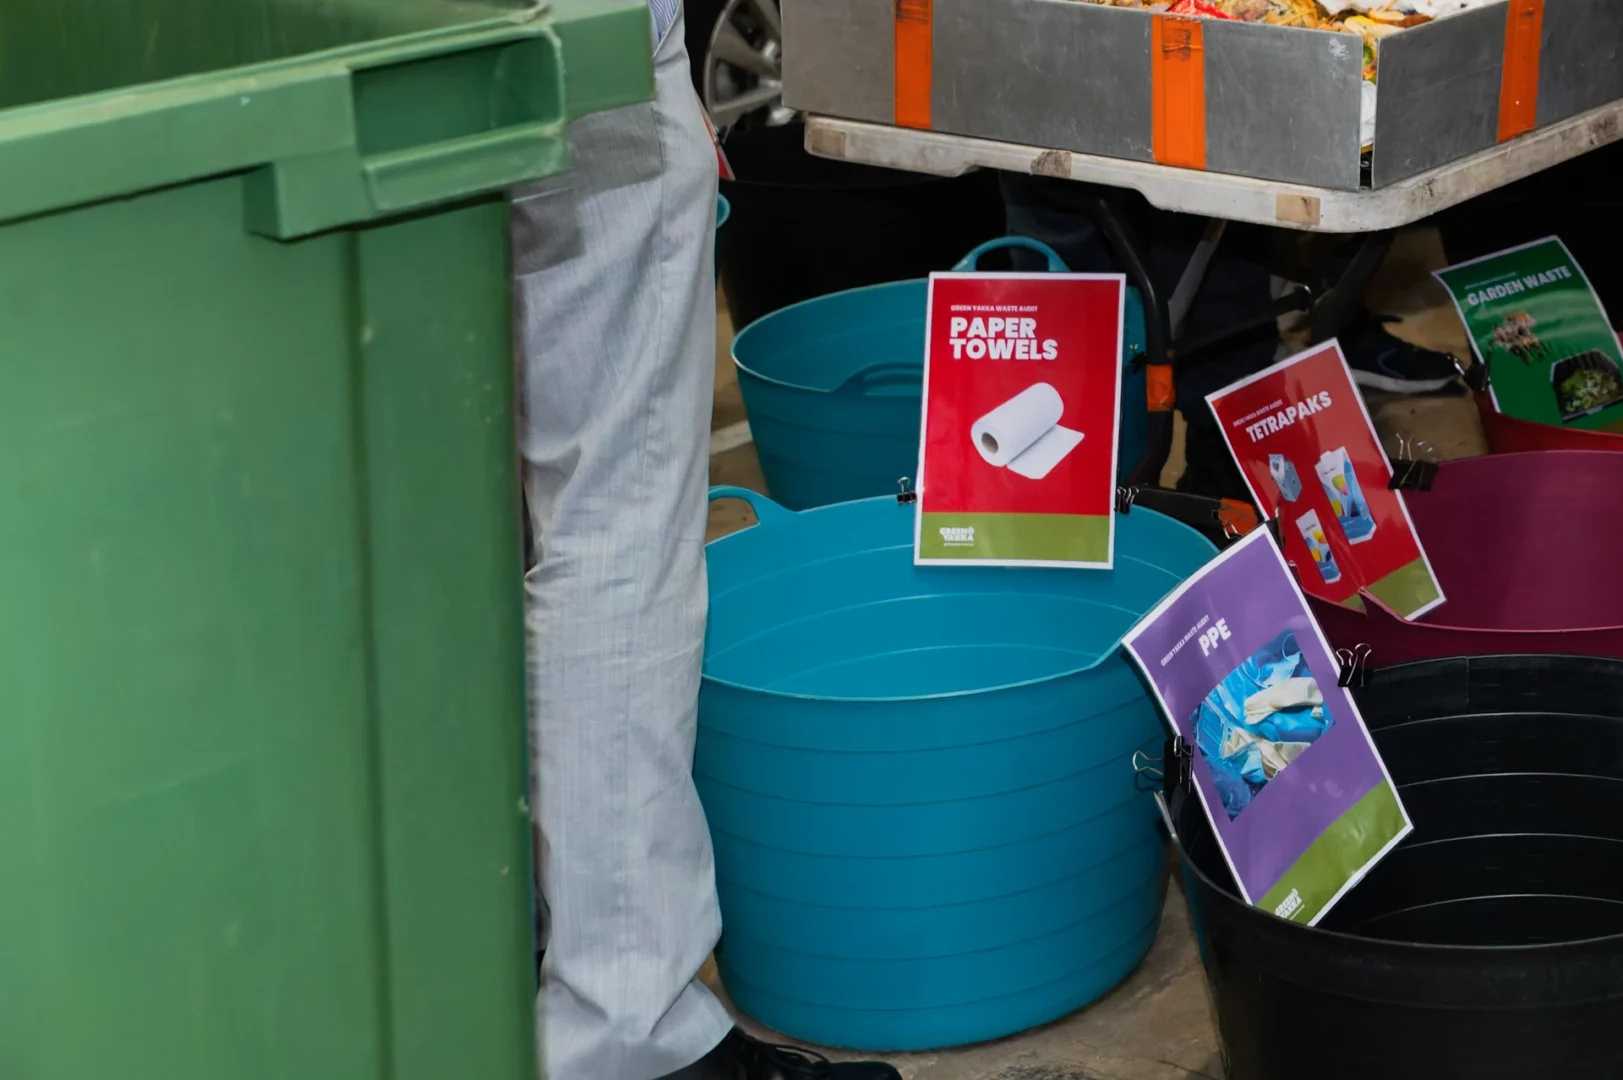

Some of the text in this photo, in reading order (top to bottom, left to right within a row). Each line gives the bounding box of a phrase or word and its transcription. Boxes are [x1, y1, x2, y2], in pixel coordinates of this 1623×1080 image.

[1467, 279, 1525, 306] GARDEN
[1523, 265, 1572, 289] WASTE
[995, 305, 1018, 313] WASTE
[1019, 305, 1038, 313] AUDIT
[950, 316, 1037, 338] PAPER
[949, 338, 1058, 360] TOWELS
[1245, 390, 1332, 443] TETRAPAKS
[1196, 614, 1210, 630] AUDIT
[1198, 617, 1232, 657] PPE
